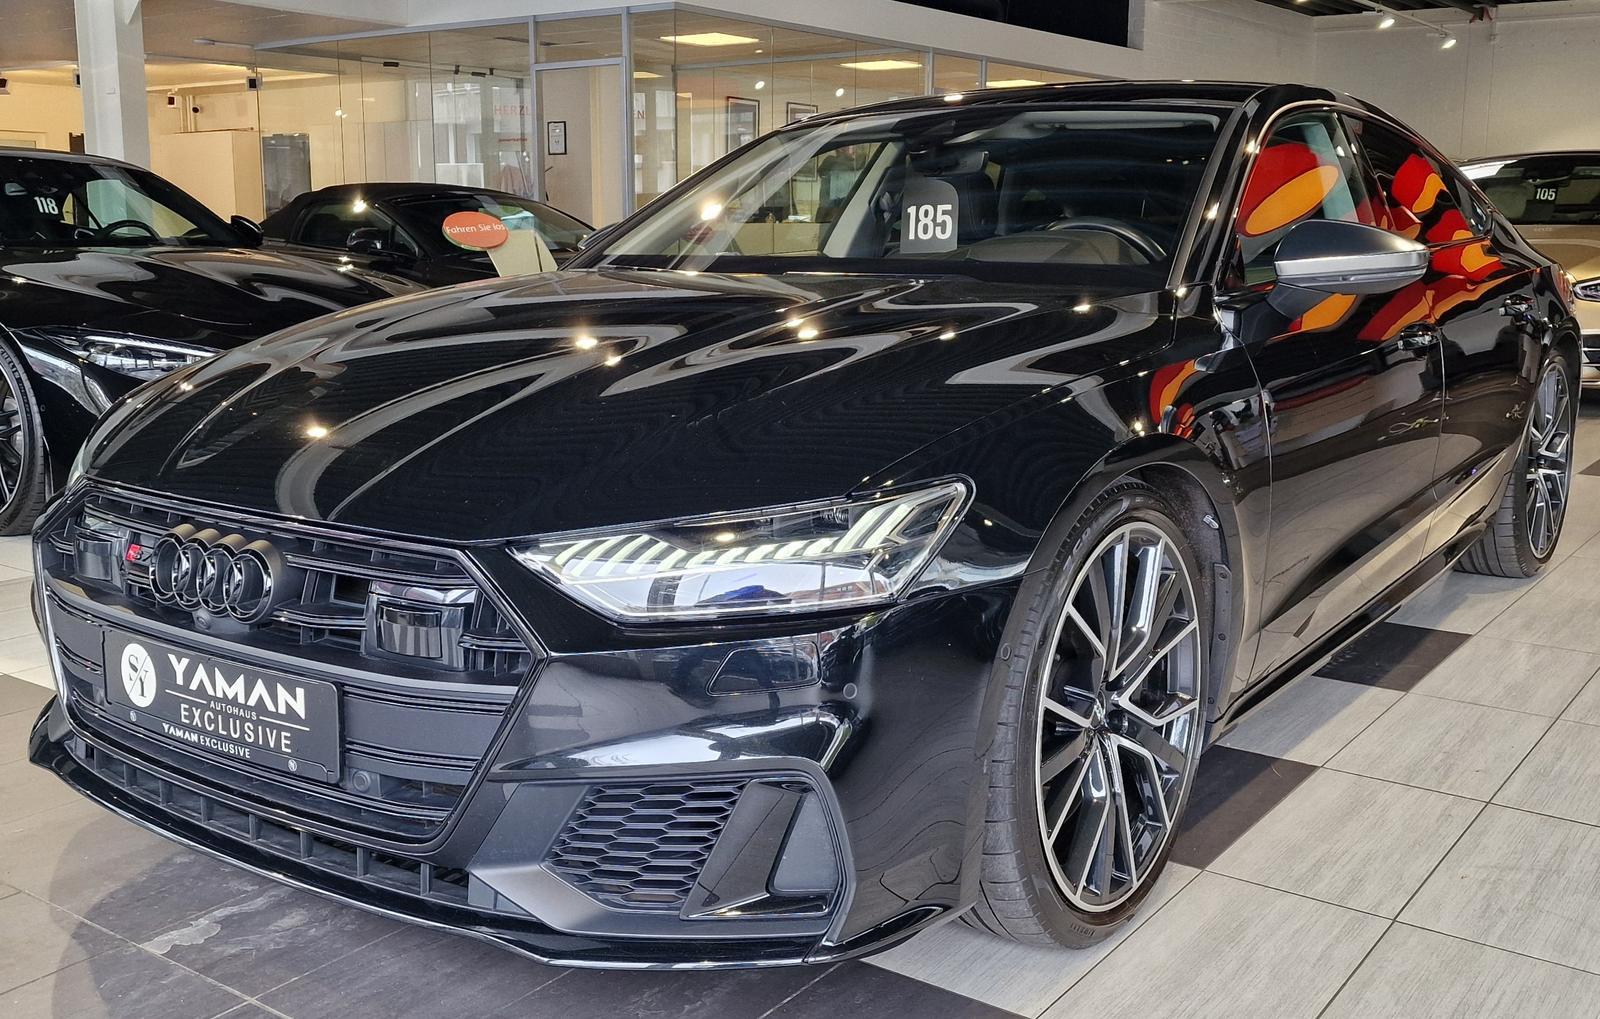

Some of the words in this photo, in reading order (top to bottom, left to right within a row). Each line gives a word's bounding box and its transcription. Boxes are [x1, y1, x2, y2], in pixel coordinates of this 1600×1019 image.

[34, 196, 59, 214] 118
[1535, 188, 1556, 200] 105
[445, 224, 477, 234] Fahren
[478, 222, 491, 232] Sie
[907, 204, 952, 240] 185
[167, 653, 306, 720] YAMAN
[209, 699, 257, 720] AUTOHAUS
[162, 722, 198, 744] YAMAN
[200, 734, 251, 758] EXCLUSIVE
[180, 703, 292, 753] EXCLUSIVE
